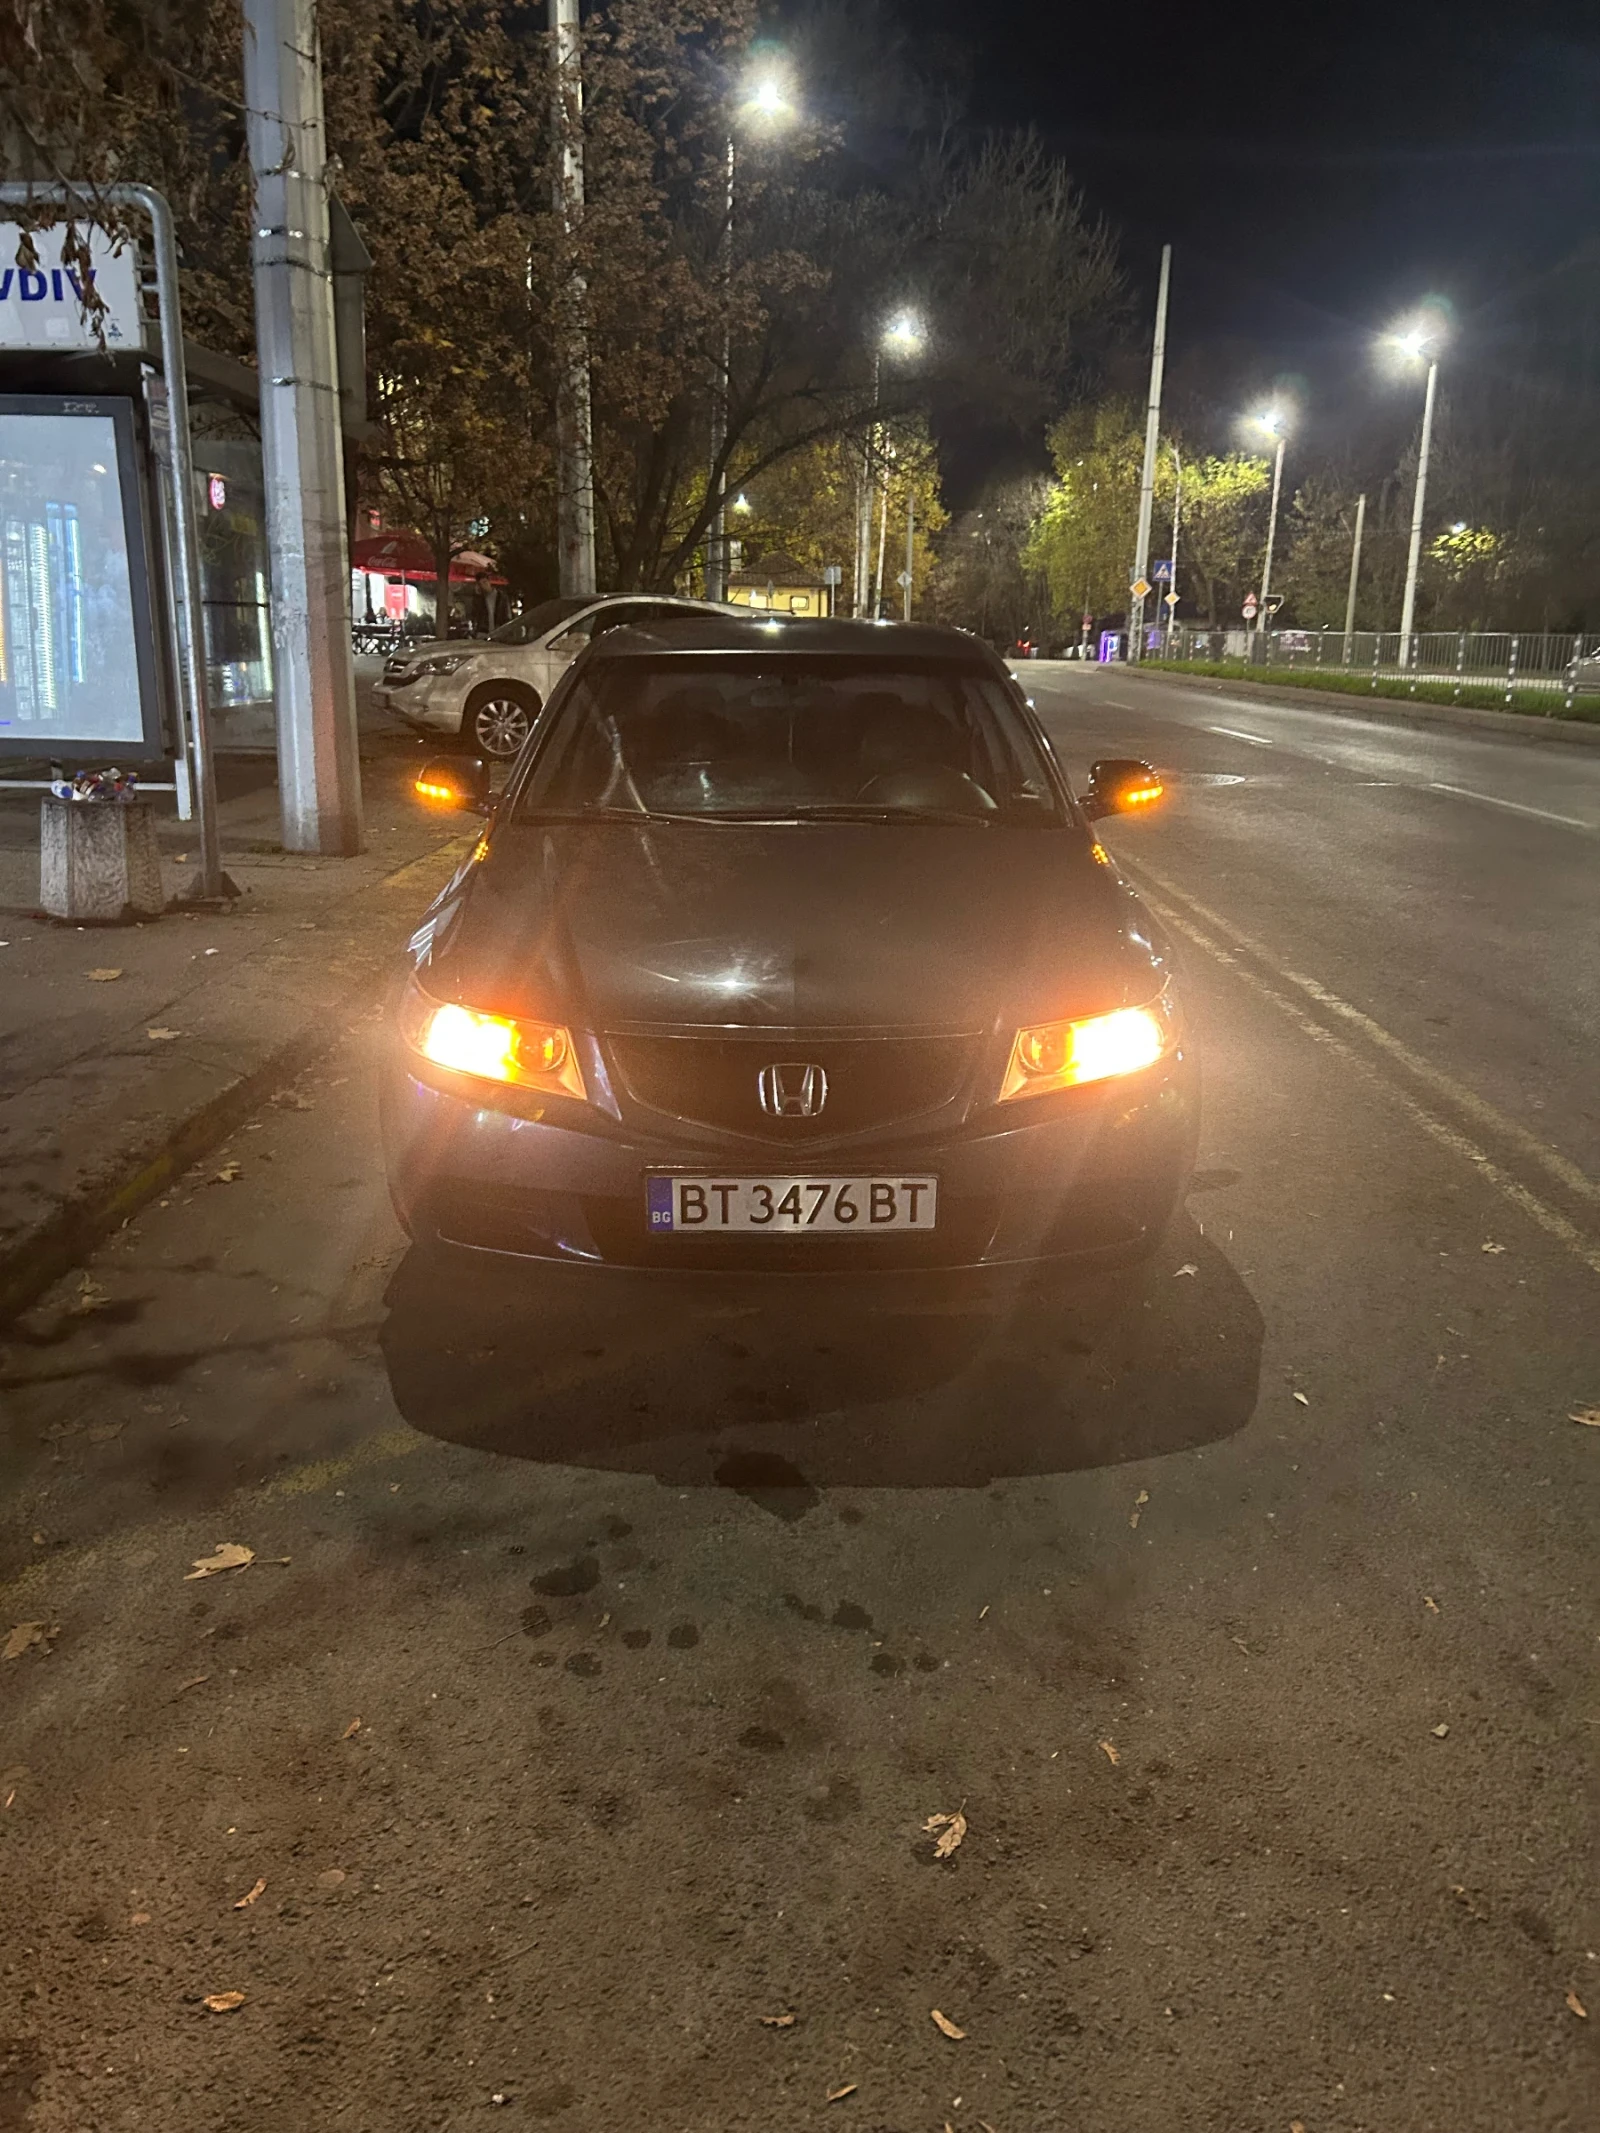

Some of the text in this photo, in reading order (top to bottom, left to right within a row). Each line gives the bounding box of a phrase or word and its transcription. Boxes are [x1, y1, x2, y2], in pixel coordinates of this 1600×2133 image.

[652, 1211, 671, 1223] BG
[680, 1183, 928, 1225] BT 3476 BT
